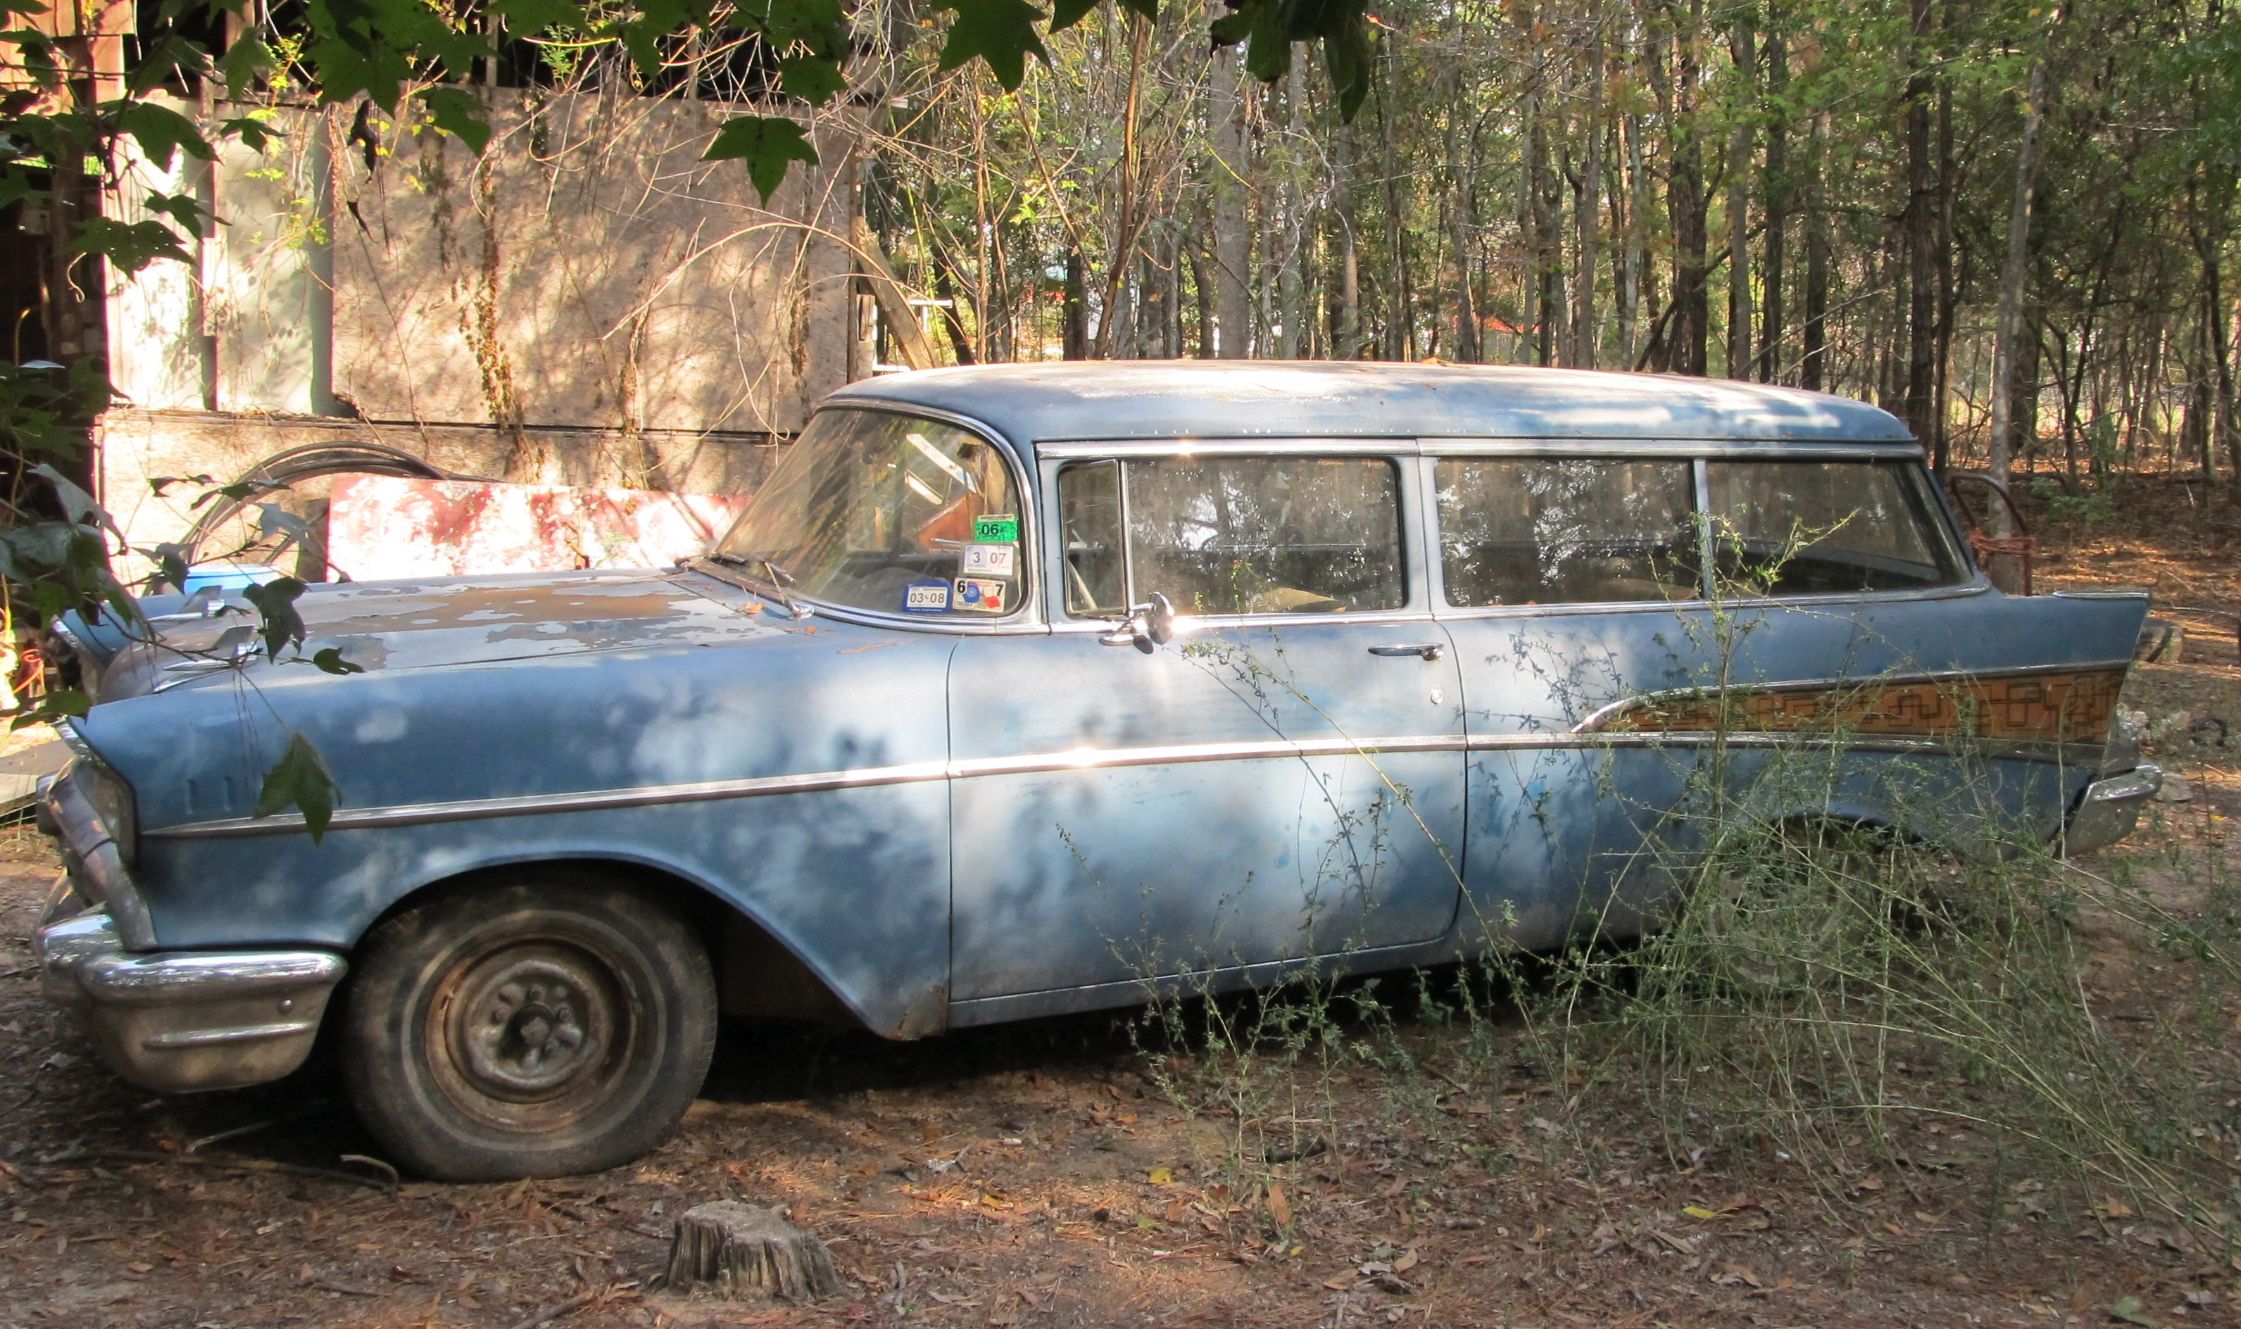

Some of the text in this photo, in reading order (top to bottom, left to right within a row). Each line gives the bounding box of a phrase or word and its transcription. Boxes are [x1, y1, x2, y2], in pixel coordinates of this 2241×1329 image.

[981, 524, 999, 535] 06
[973, 551, 1006, 564] 3 07
[957, 580, 1004, 596] 6 7
